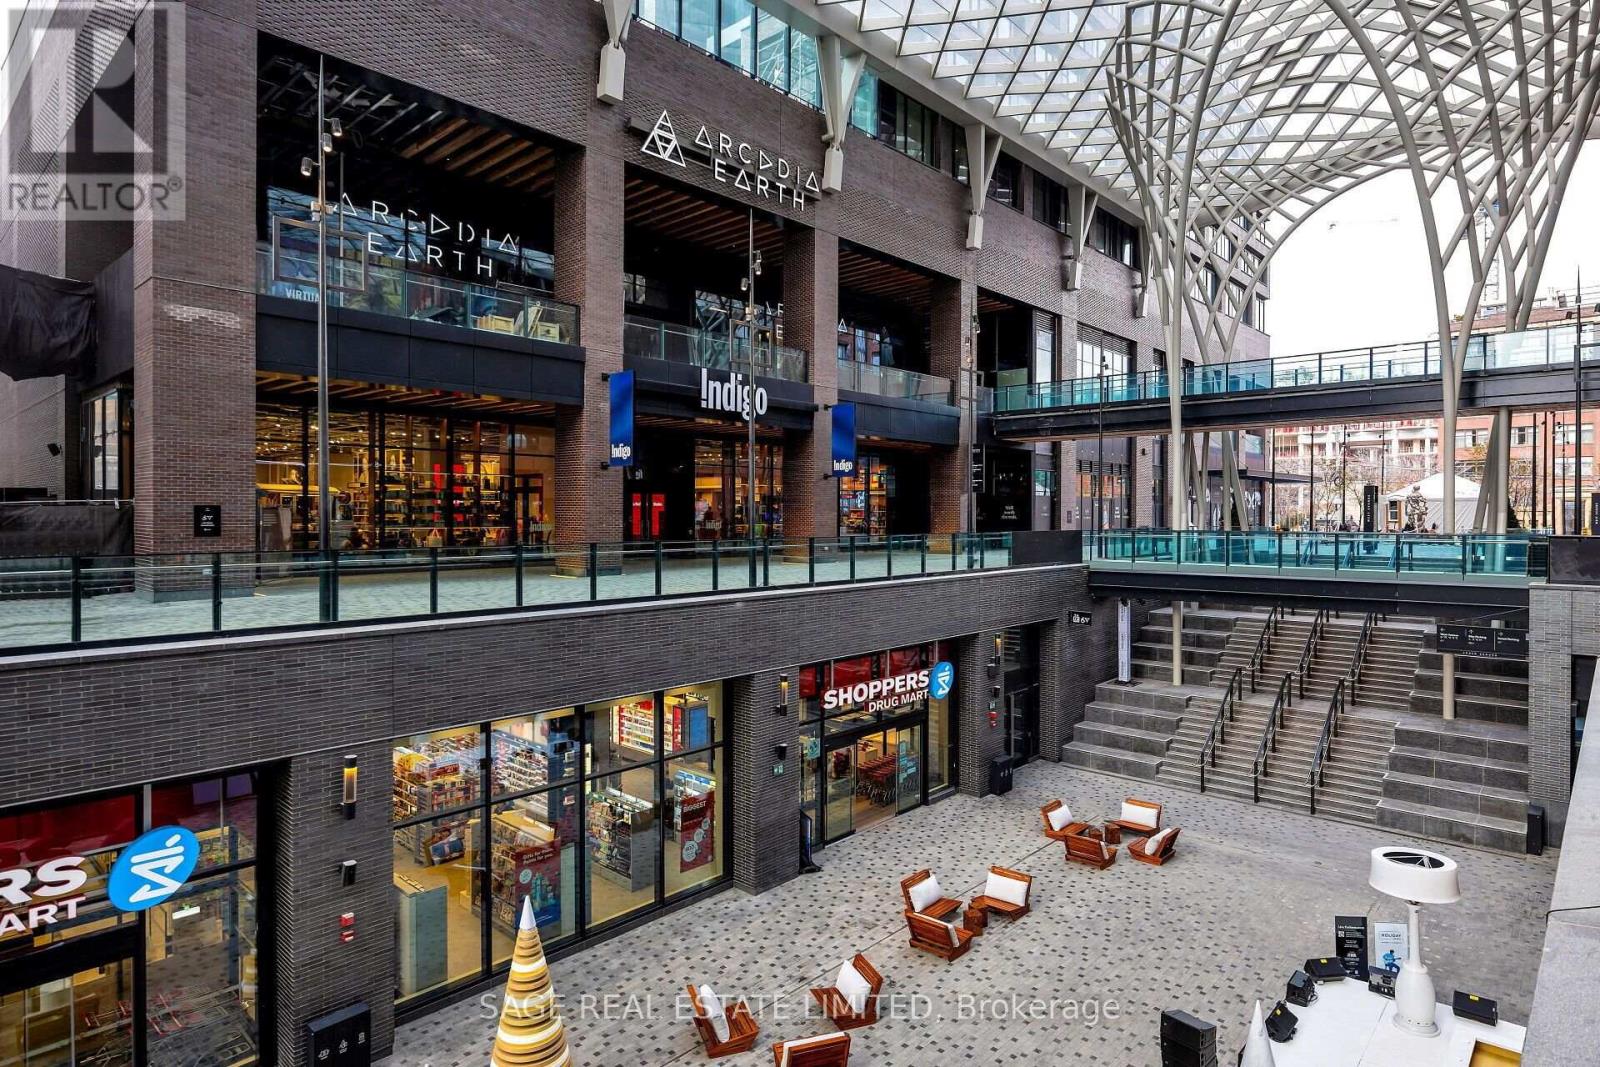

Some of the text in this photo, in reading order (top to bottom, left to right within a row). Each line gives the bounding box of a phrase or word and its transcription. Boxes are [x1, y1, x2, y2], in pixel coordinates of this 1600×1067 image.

[714, 158, 805, 212] EARTH
[368, 232, 493, 278] EARTH
[285, 287, 320, 303] VIRTUA
[701, 367, 768, 421] Indigo
[611, 443, 631, 460] Indigo
[834, 459, 853, 473] Indigo
[823, 669, 930, 710] SHOPPERS
[868, 689, 930, 713] DRUG MART
